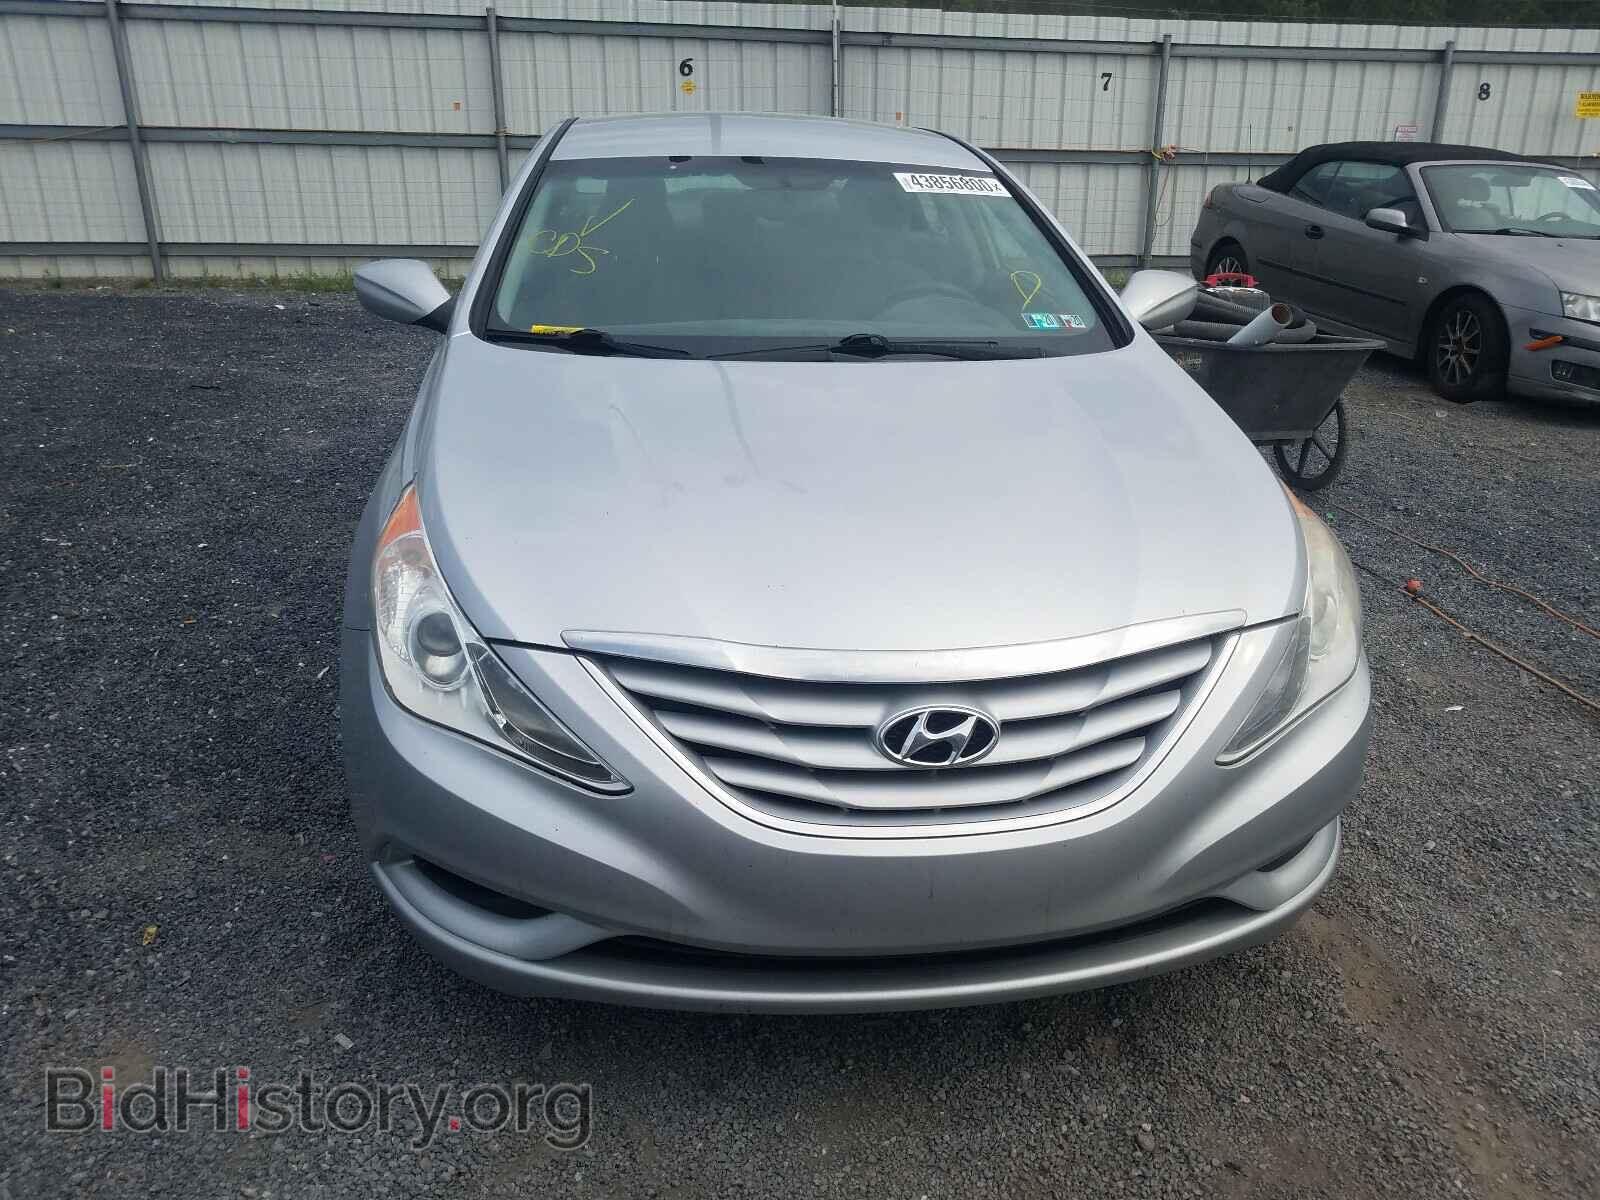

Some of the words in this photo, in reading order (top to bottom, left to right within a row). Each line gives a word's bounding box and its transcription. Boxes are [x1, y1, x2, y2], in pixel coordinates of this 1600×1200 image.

[680, 58, 693, 76] 6
[1101, 73, 1112, 91] 7
[1479, 83, 1490, 101] 8
